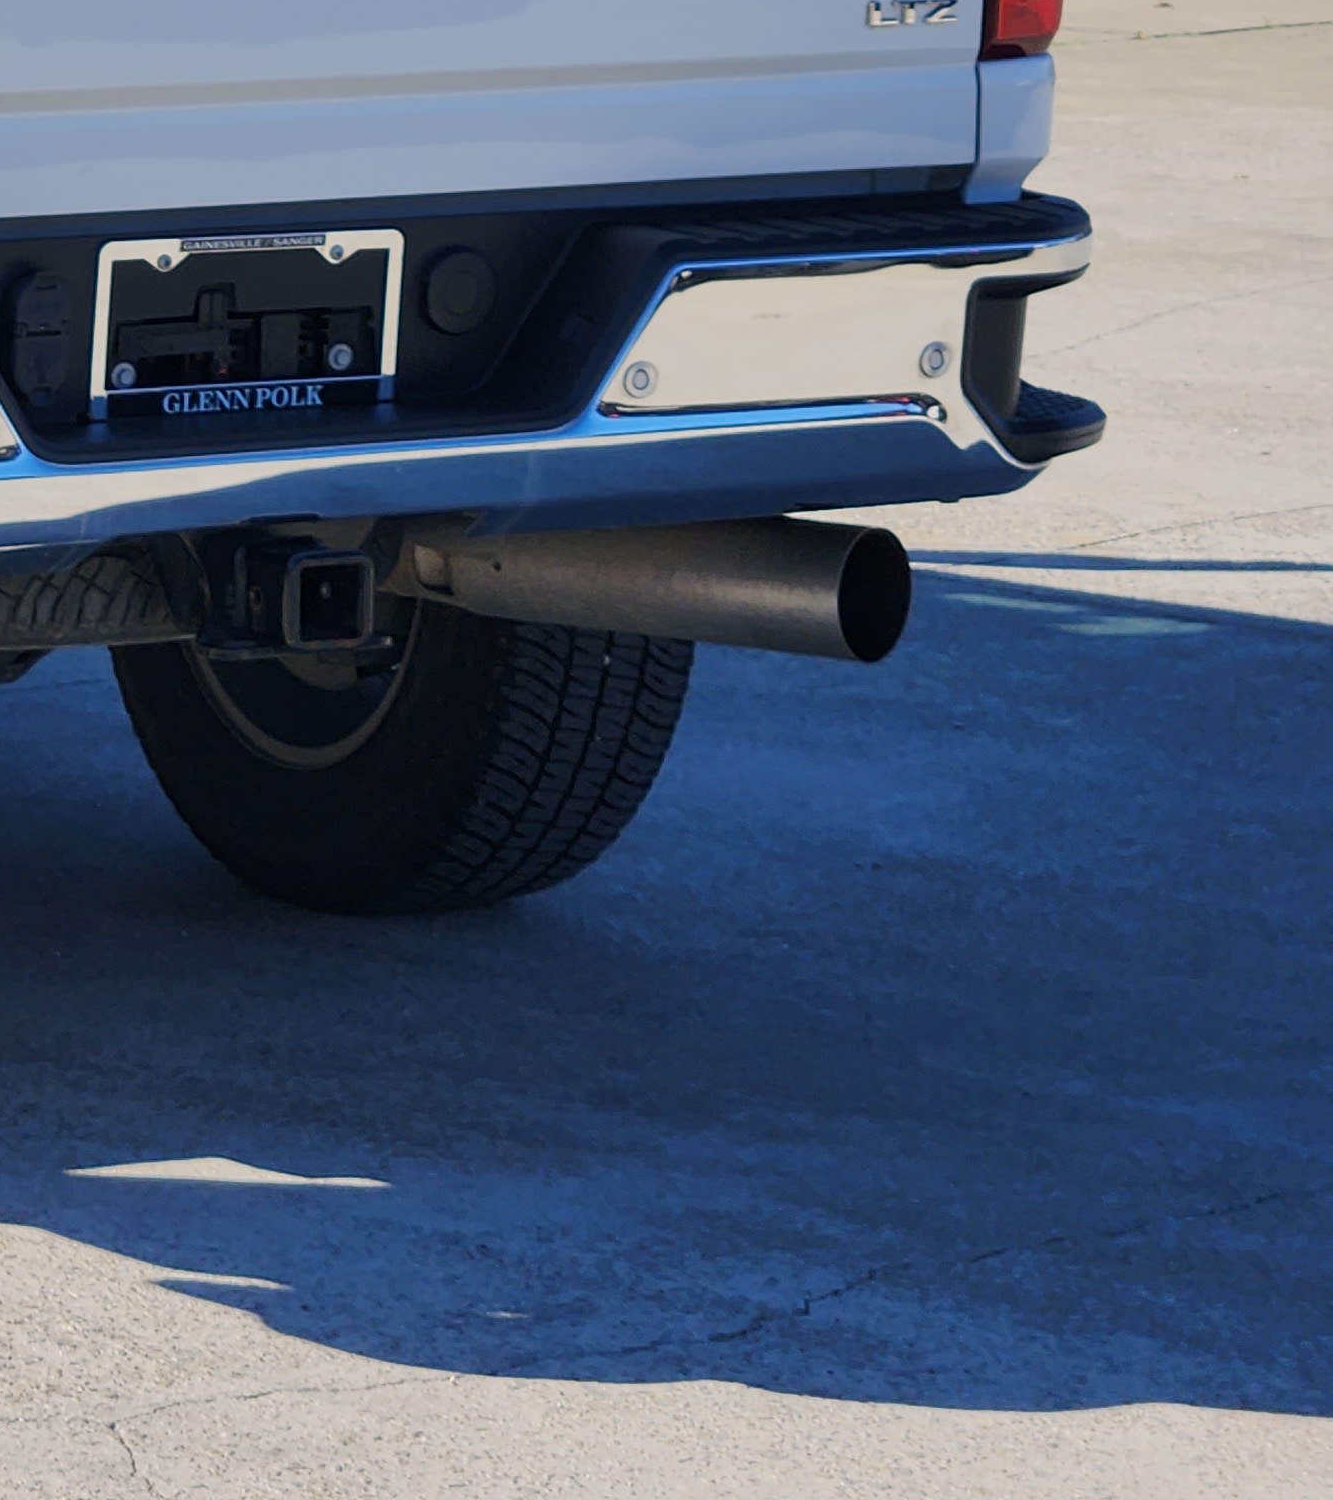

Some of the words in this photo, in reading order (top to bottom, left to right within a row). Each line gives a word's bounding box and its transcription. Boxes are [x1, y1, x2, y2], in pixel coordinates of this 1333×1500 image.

[183, 238, 262, 251] GAINESVILLE
[272, 235, 324, 247] SANGER
[162, 388, 251, 414] GLENN
[255, 385, 324, 409] POLK
